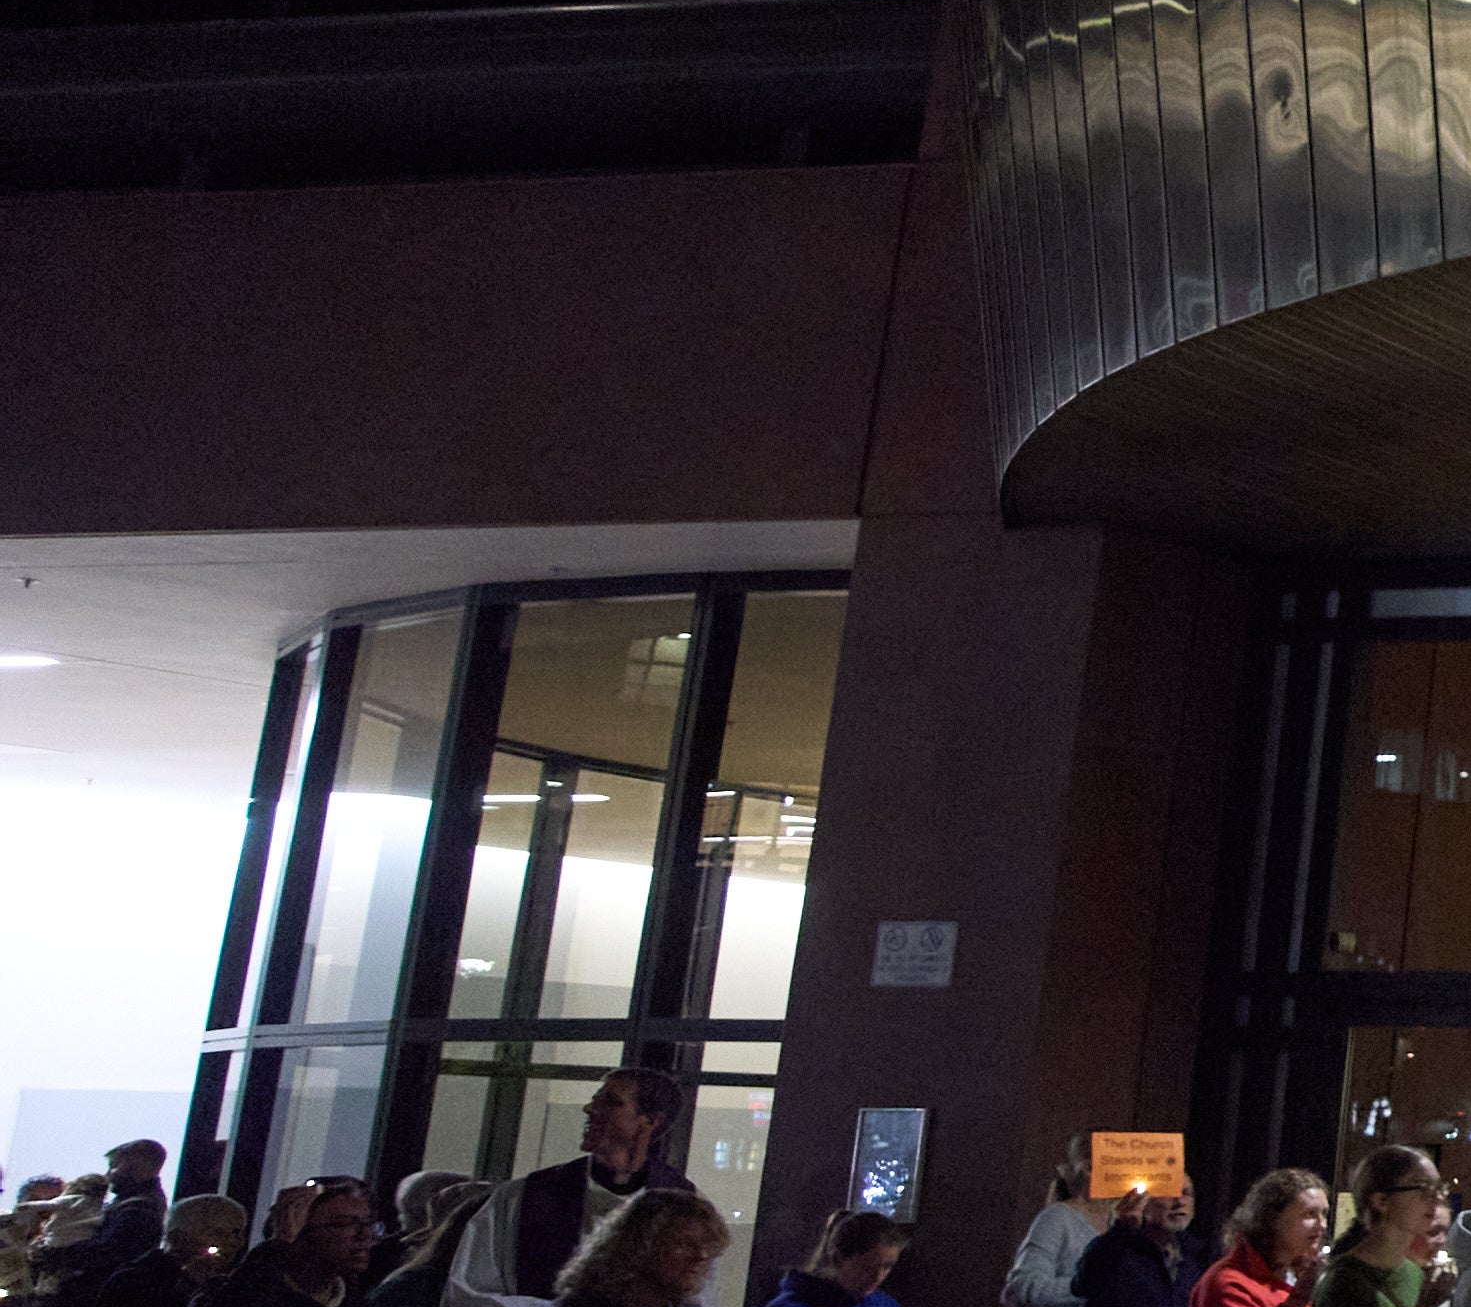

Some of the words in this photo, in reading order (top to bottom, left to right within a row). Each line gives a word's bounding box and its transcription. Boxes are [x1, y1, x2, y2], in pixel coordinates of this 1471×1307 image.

[1104, 1138, 1126, 1149] The
[1130, 1138, 1172, 1149] Church
[1100, 1155, 1142, 1165] Stands
[1104, 1172, 1171, 1183] Immrants
